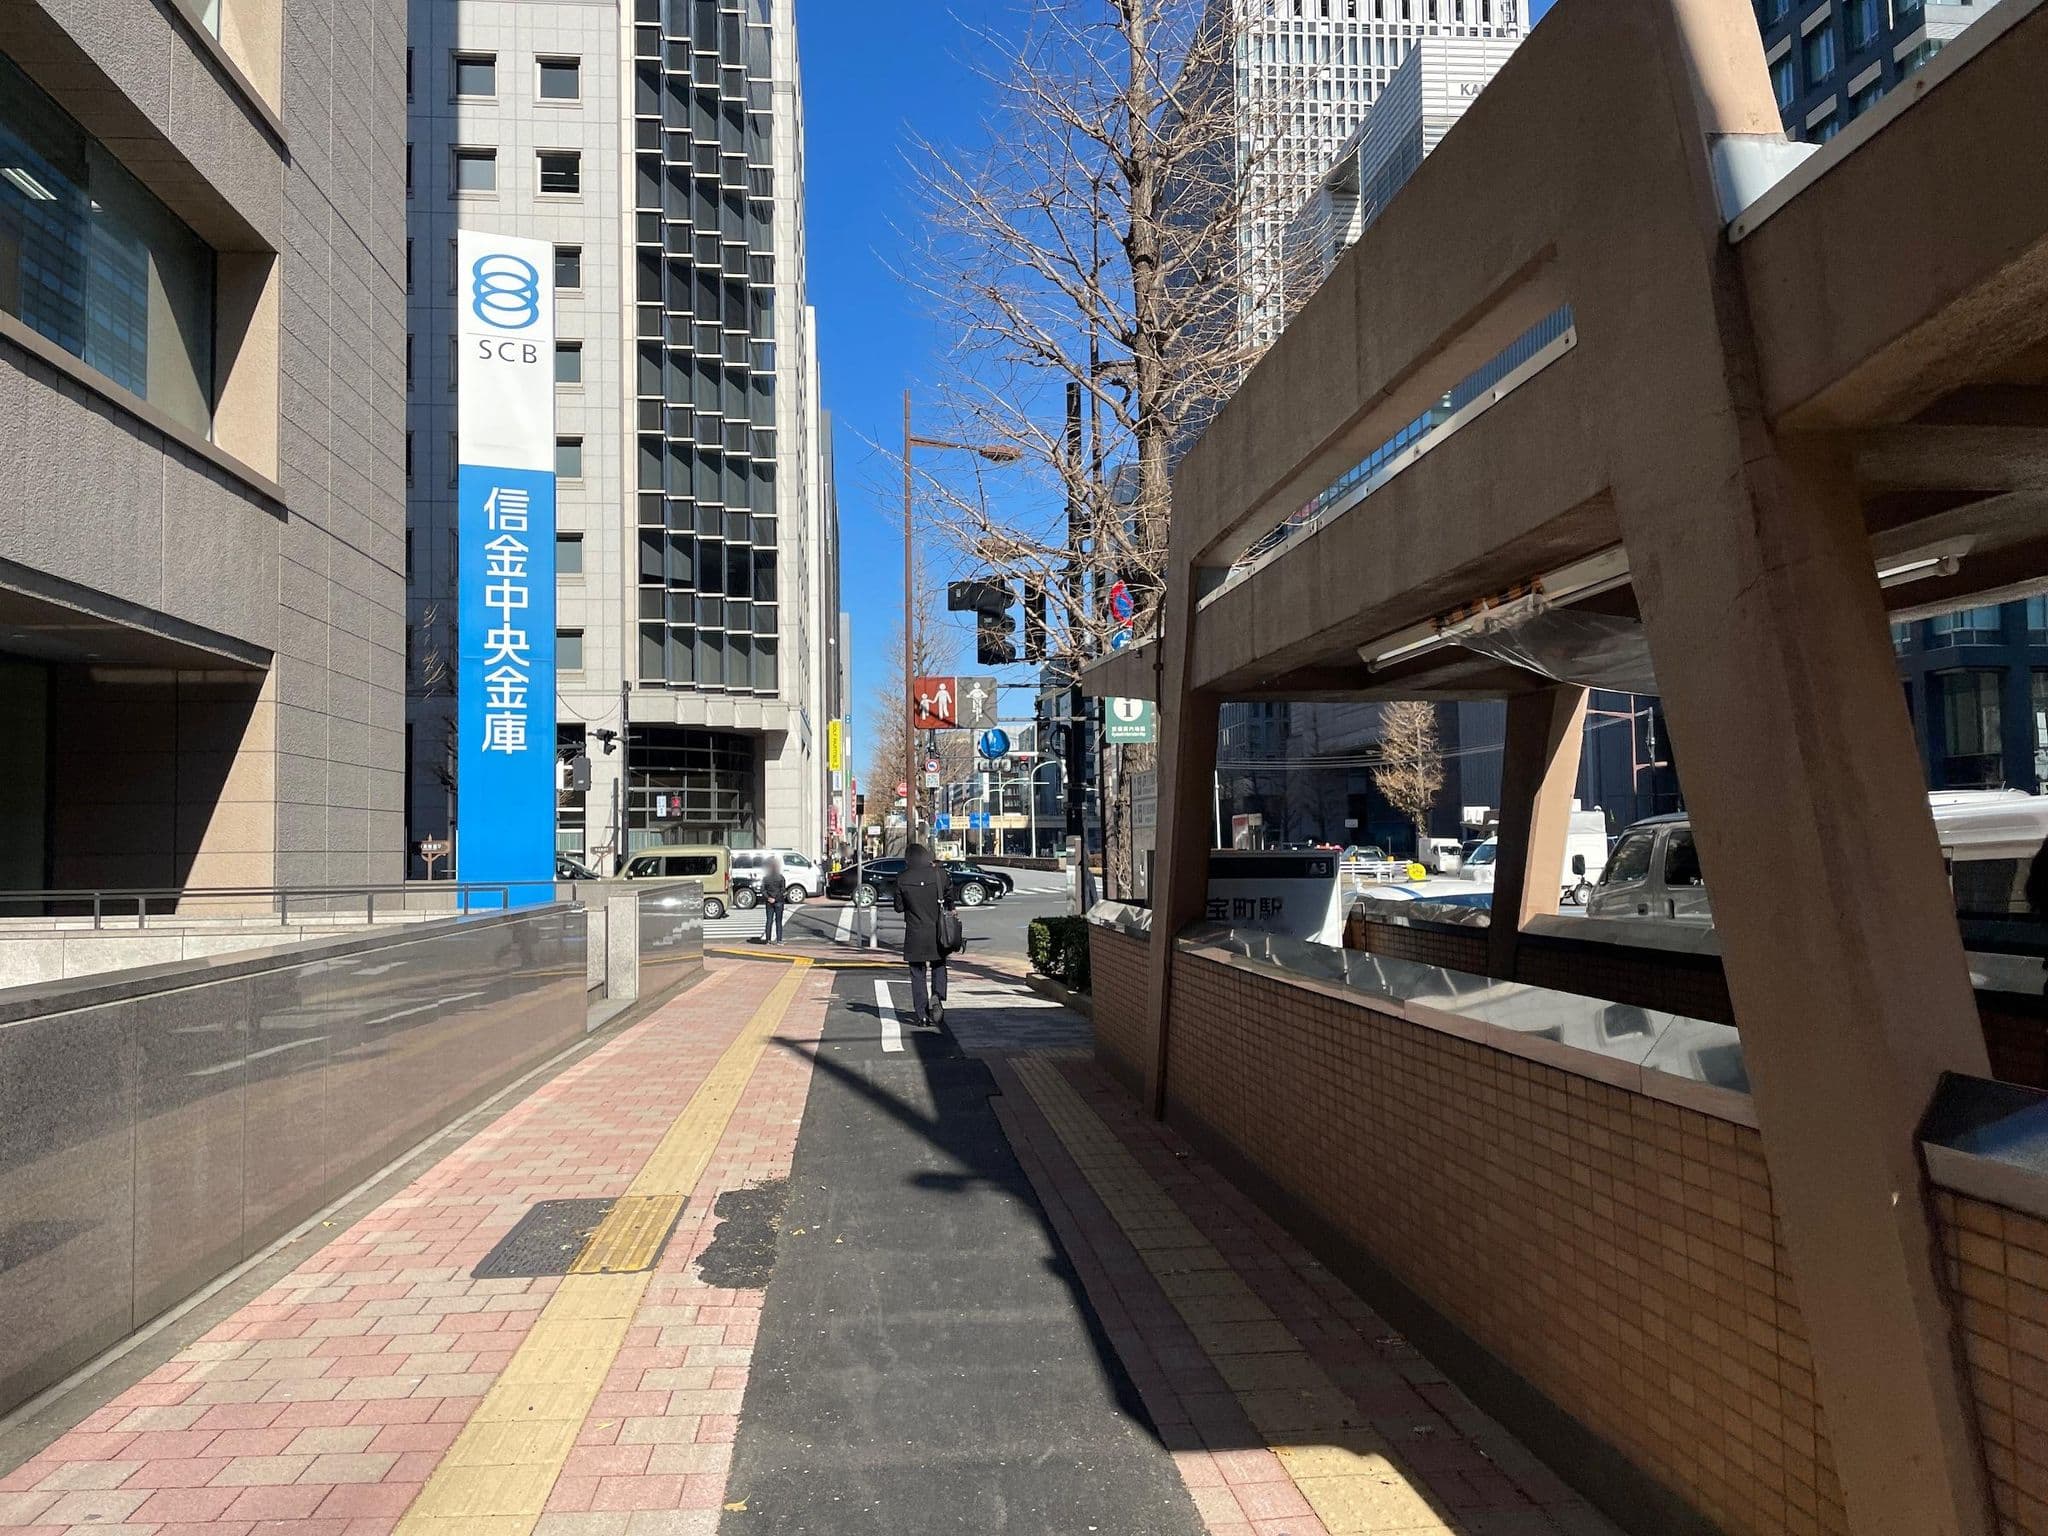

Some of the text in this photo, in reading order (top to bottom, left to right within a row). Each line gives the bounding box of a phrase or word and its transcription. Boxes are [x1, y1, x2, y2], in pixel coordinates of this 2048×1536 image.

[479, 338, 537, 364] SCB
[482, 486, 530, 755] 信金中央金庫
[1207, 896, 1283, 921] 宝町駅
